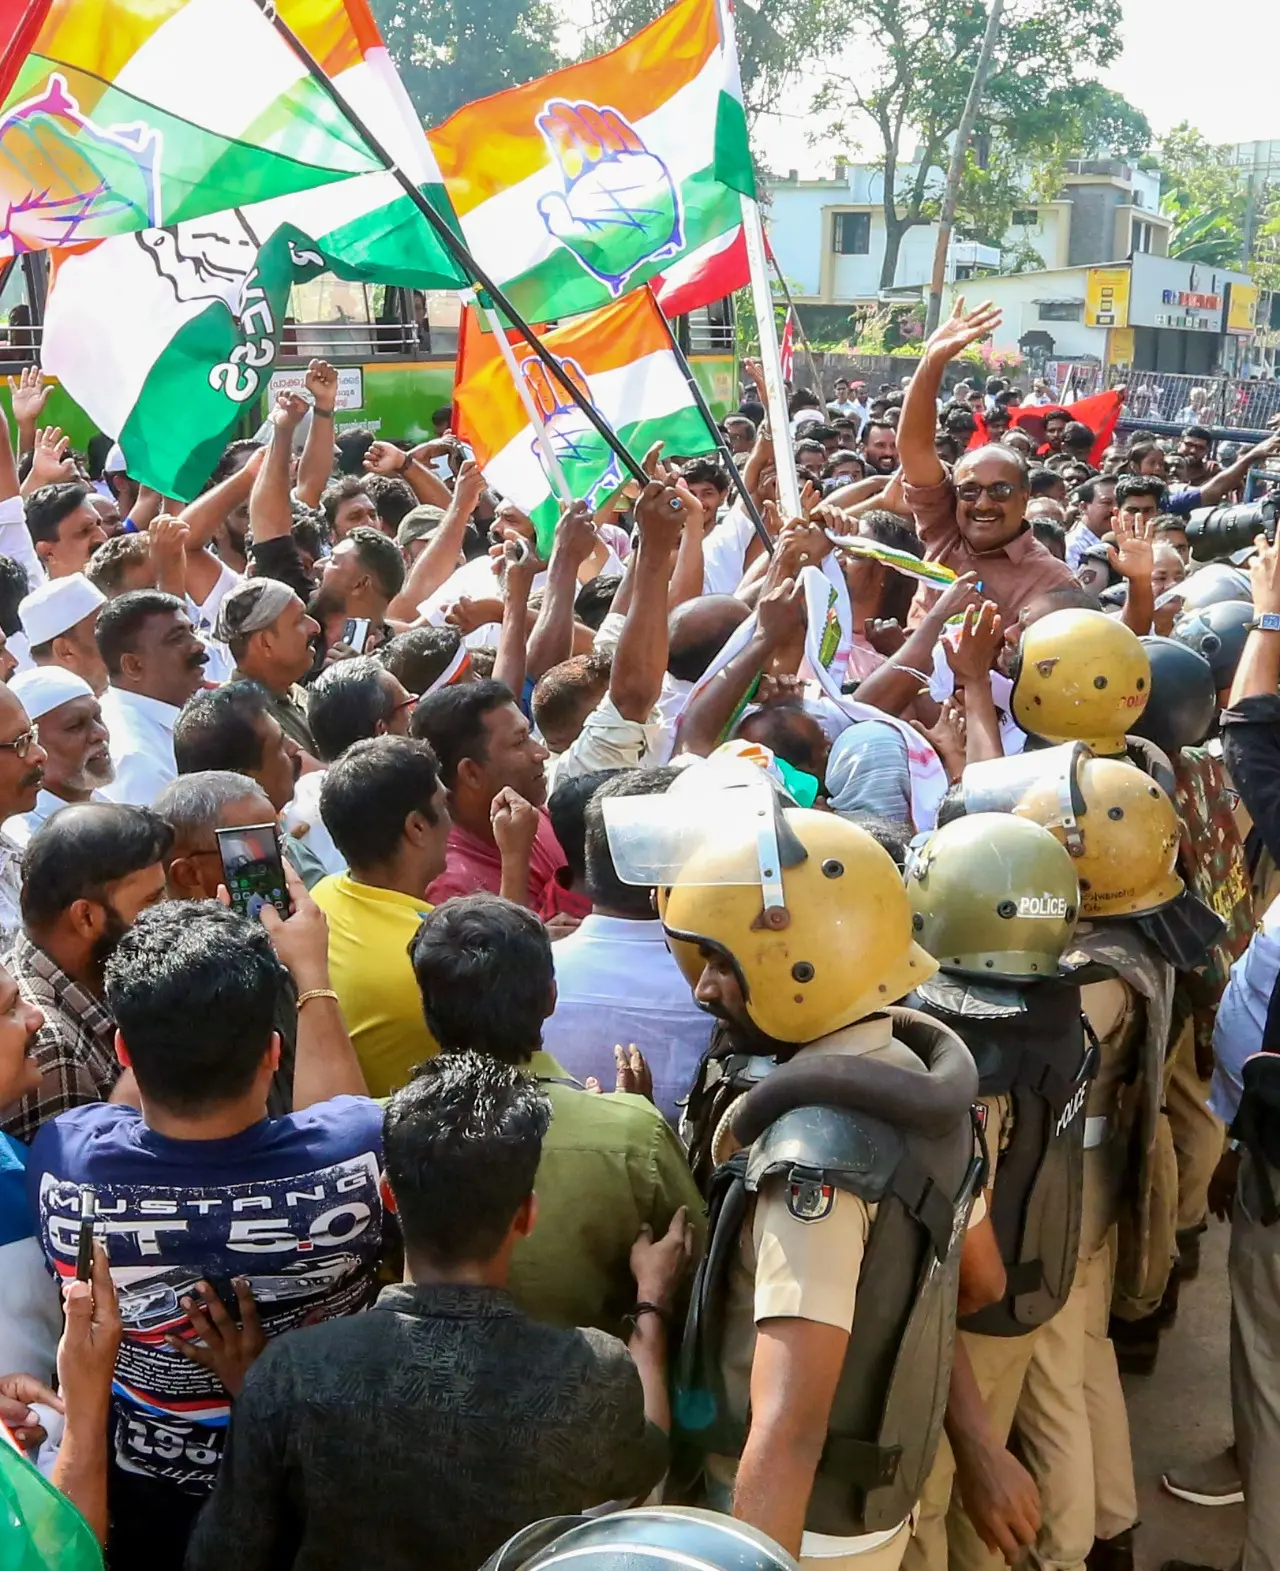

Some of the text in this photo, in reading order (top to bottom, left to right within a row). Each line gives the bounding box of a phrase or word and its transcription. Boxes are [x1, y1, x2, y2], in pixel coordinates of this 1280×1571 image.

[1020, 897, 1066, 915] POLICE
[1055, 1080, 1088, 1137] POLICE
[48, 1170, 368, 1216] MUSTANG
[47, 1201, 372, 1257] GT 5.0
